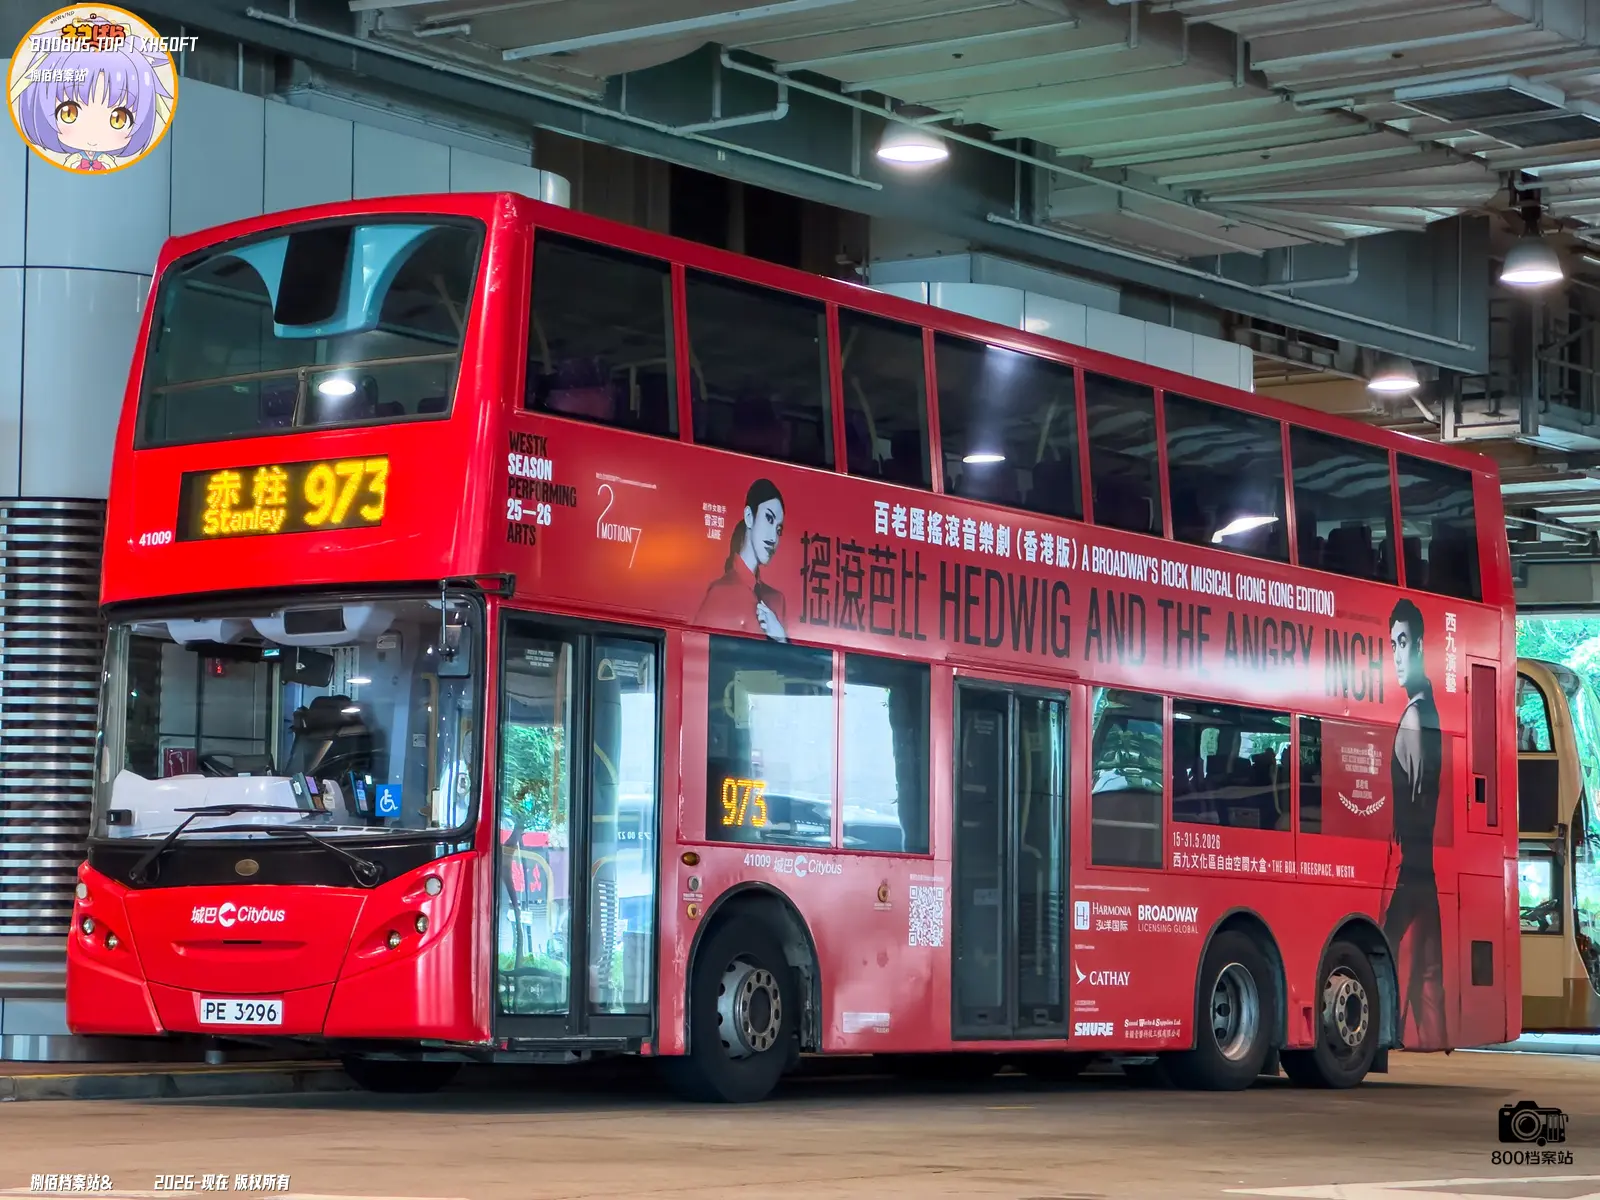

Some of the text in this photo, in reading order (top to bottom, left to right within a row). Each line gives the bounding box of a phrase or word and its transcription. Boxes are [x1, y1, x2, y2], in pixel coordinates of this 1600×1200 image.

[508, 430, 548, 457] WESTK
[507, 453, 552, 481] SEASON
[206, 465, 288, 509] 赤柱
[303, 458, 389, 525] 973
[507, 477, 577, 508] PERFORMING
[203, 506, 286, 535] Stanley
[138, 531, 172, 547] 41009
[507, 522, 536, 546] ARTS
[1081, 544, 1089, 571] A
[1092, 548, 1159, 584] BROADWAY'S
[1161, 559, 1189, 590] ROCK
[1191, 567, 1233, 599] MUSICAL
[1236, 573, 1266, 604] (HONG
[1268, 581, 1294, 608] KONG
[1296, 585, 1335, 618] EDITION)
[939, 560, 1071, 659] HEDWIG
[1084, 587, 1146, 666] AND
[1157, 598, 1212, 678] THE
[1224, 611, 1314, 700] ANGRY
[1324, 628, 1384, 704] INCH
[721, 776, 768, 829] 973
[1172, 831, 1221, 850] 15-31.5.2026
[743, 853, 771, 868] 41009
[774, 858, 843, 875] 城巴 Citybus
[1272, 860, 1283, 873] THE
[191, 906, 286, 924] 城巴 Citybus
[1092, 902, 1132, 916] HARMONIA
[1138, 904, 1199, 923] BROADWAY
[1138, 924, 1199, 934] LICENSING GLOBAL
[1089, 971, 1130, 986] CATHAY
[206, 1002, 277, 1022] PE 3296
[1074, 1022, 1114, 1037] SHURE
